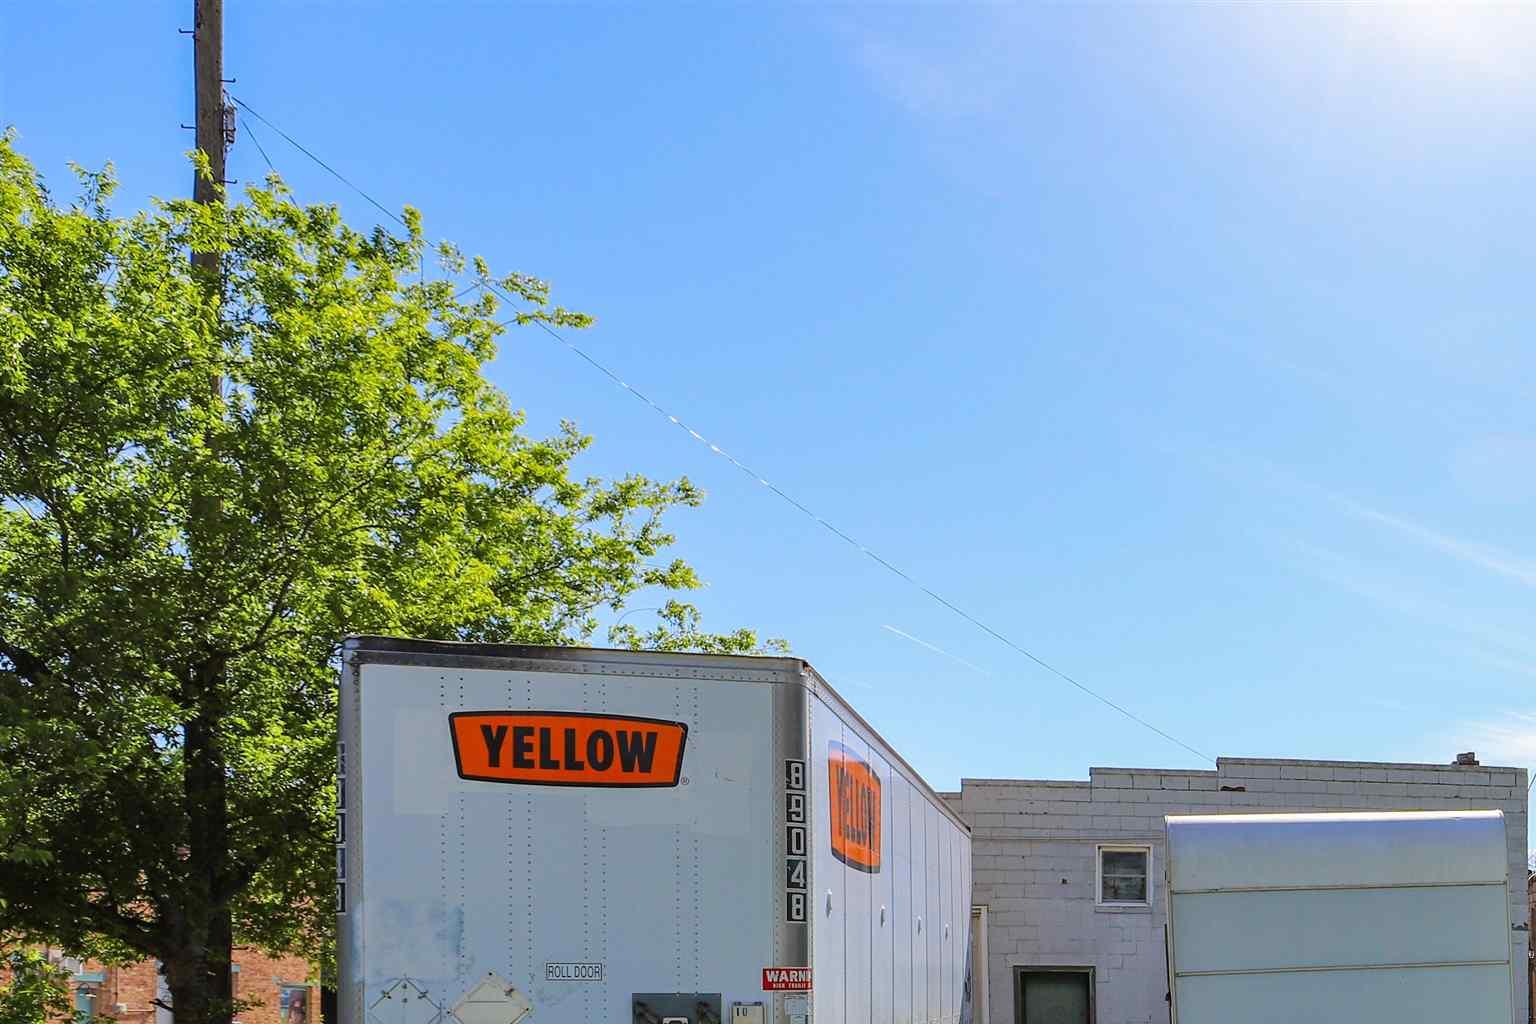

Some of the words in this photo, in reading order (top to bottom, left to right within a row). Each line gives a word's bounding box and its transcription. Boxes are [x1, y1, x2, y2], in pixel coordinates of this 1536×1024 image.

[480, 724, 658, 773] YELLOW
[789, 761, 806, 922] 89048
[548, 965, 572, 978] ROLL
[575, 965, 600, 978] DOOR
